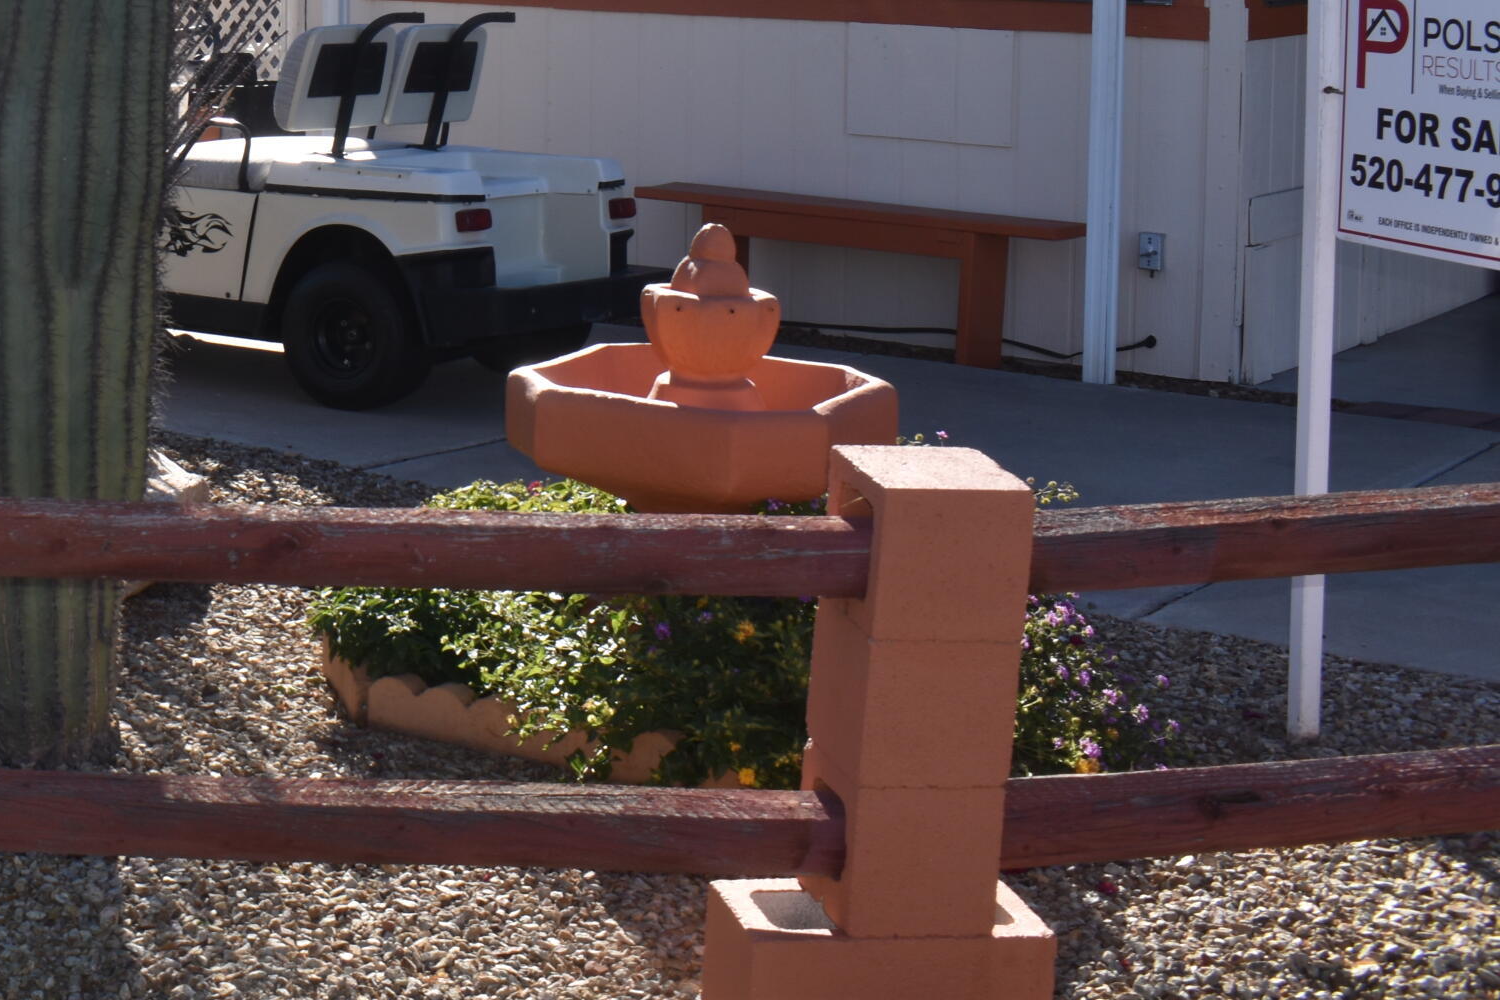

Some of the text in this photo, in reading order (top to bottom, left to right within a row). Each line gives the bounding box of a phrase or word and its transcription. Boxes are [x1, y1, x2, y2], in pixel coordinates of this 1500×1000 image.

[1423, 17, 1500, 53] POLS
[1376, 107, 1500, 155] FOR SA
[1350, 153, 1500, 209] 520-477-9
[1378, 216, 1393, 227] EACH
[1393, 219, 1413, 231] OFFICE
[1414, 223, 1420, 232] IS
[1421, 224, 1469, 241] INDEPENDENTLY
[1469, 232, 1493, 245] OWNED
